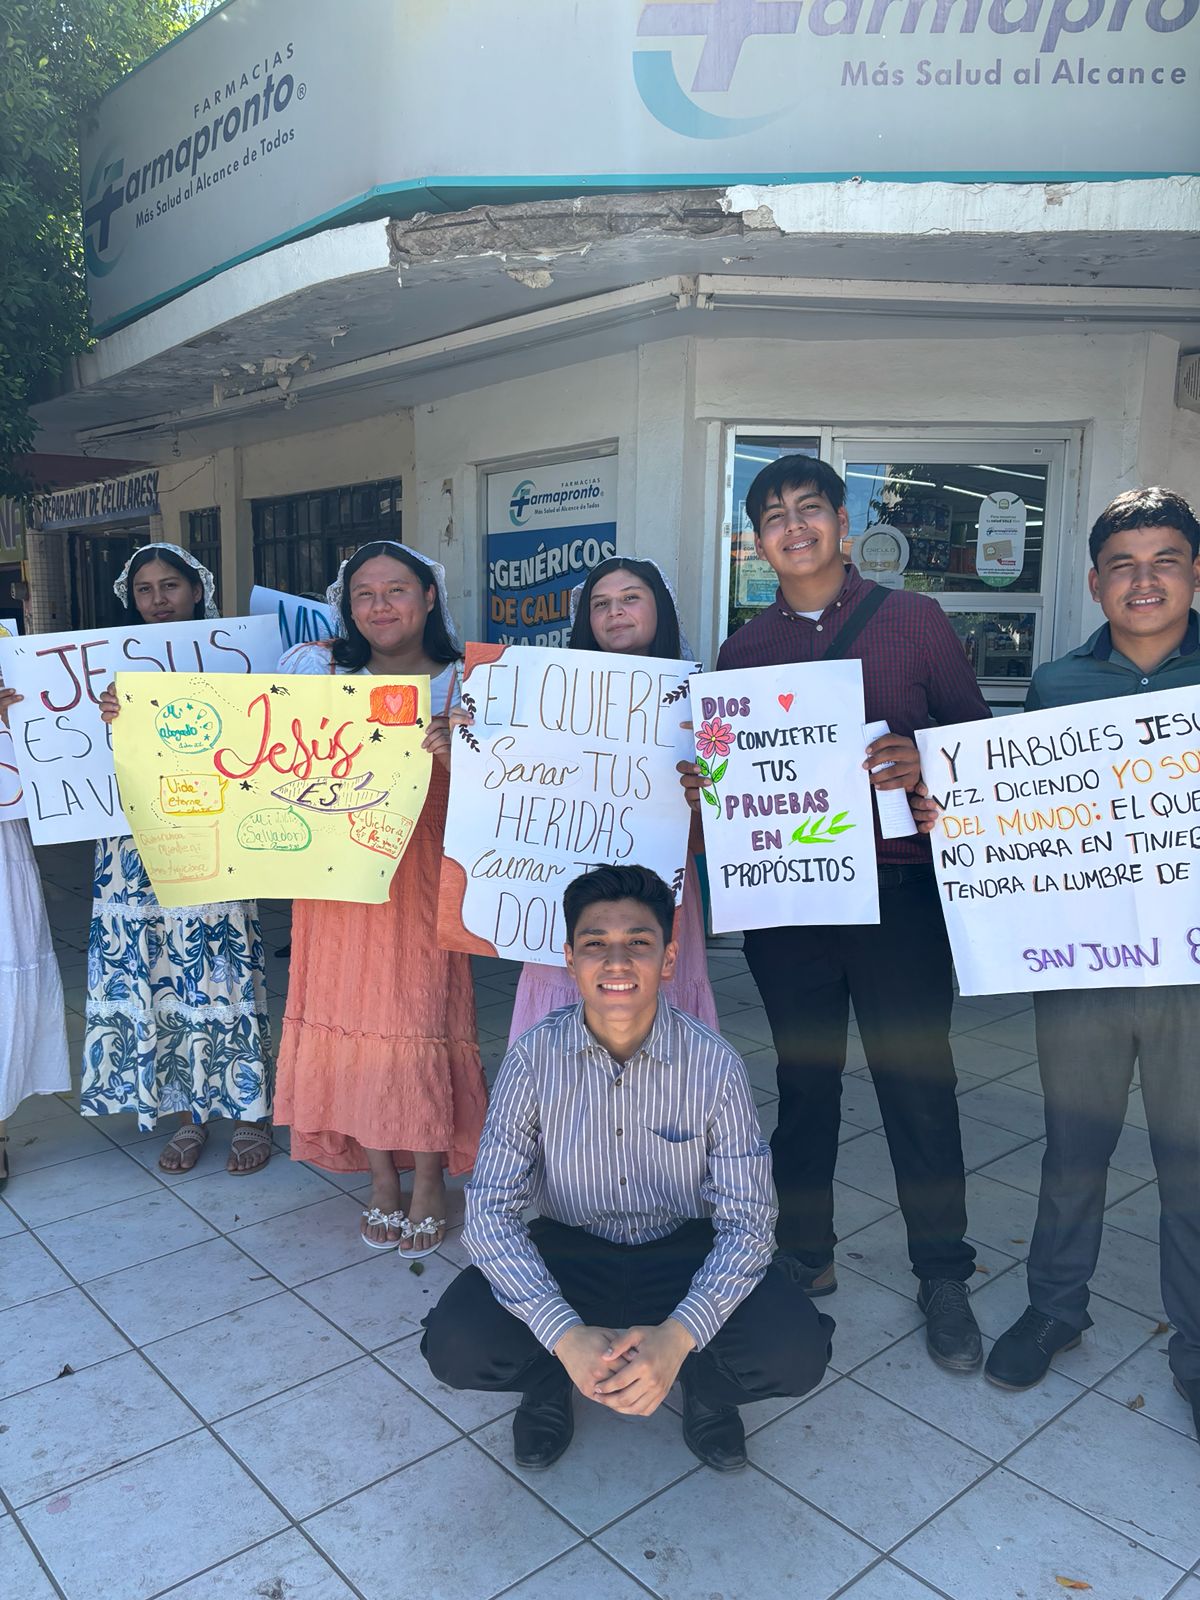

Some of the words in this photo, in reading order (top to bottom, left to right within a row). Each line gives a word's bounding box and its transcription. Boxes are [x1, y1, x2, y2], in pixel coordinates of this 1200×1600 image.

[194, 42, 294, 118] FARMACIAS
[841, 61, 904, 86] Más
[916, 59, 1001, 86] Salud
[1013, 60, 1040, 85] al
[1052, 58, 1187, 85] Alcance
[136, 210, 154, 229] Más
[156, 189, 182, 217] Salud
[184, 181, 193, 201] al
[196, 158, 239, 194] Alcance
[243, 147, 257, 166] de
[260, 128, 295, 156] Todos
[90, 487, 100, 516] DE
[102, 475, 154, 513] CELULARES
[561, 478, 600, 488] FARMACIAS
[279, 600, 340, 648] NAD
[492, 595, 516, 625] DE
[521, 589, 572, 626] CALI
[484, 664, 528, 728] EL
[540, 663, 679, 748] QUIERE
[701, 696, 750, 720] DIOS
[24, 715, 92, 763] ES
[736, 723, 838, 751] CONVIERTE
[941, 741, 961, 783] Y
[986, 726, 1124, 770] HABLÓLES
[484, 736, 579, 790] Sanar
[583, 750, 651, 801] TUS
[752, 760, 798, 782] TUS
[994, 769, 1100, 802] DICIENDO
[1112, 759, 1153, 790] YO
[1160, 751, 1200, 780] SO
[296, 781, 344, 806] ES
[725, 788, 829, 820] PRUEBAS
[495, 792, 635, 859] HERIDAS
[943, 815, 986, 838] DEL
[1111, 795, 1145, 821] EL
[751, 829, 783, 851] EN
[941, 843, 975, 869] NO
[986, 837, 1073, 863] ANDARA
[1082, 831, 1113, 854] EN
[720, 856, 856, 888] PROPÓSITOS
[943, 876, 1025, 901] TENDRA
[1034, 875, 1059, 893] LA
[1064, 863, 1144, 891] LUMBRE
[1157, 862, 1191, 884] DE
[1023, 943, 1075, 972] SAN
[1081, 937, 1159, 972] JUAN
